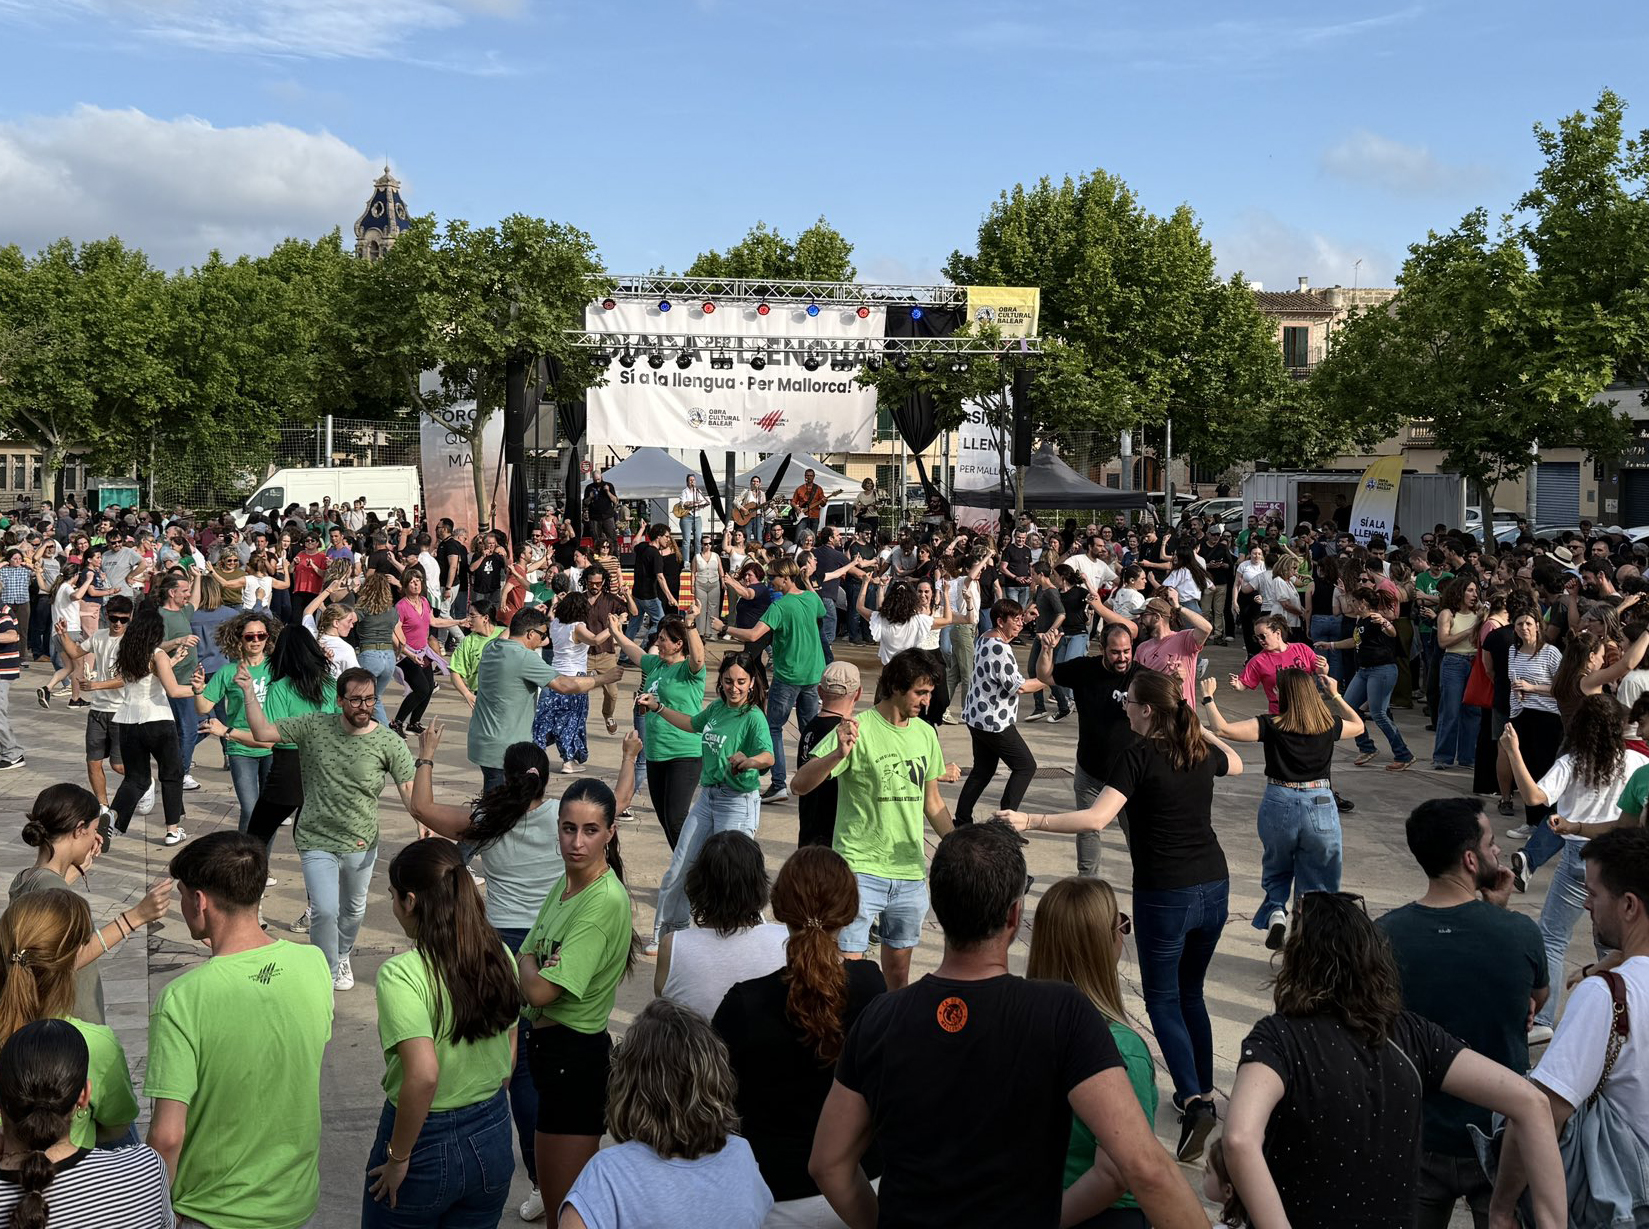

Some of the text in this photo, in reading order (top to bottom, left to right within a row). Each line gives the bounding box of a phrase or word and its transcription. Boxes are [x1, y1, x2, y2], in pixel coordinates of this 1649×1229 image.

[620, 368, 852, 394] Sí a la llengua Per Mallorca!
[1360, 516, 1386, 530] SÍ A LA
